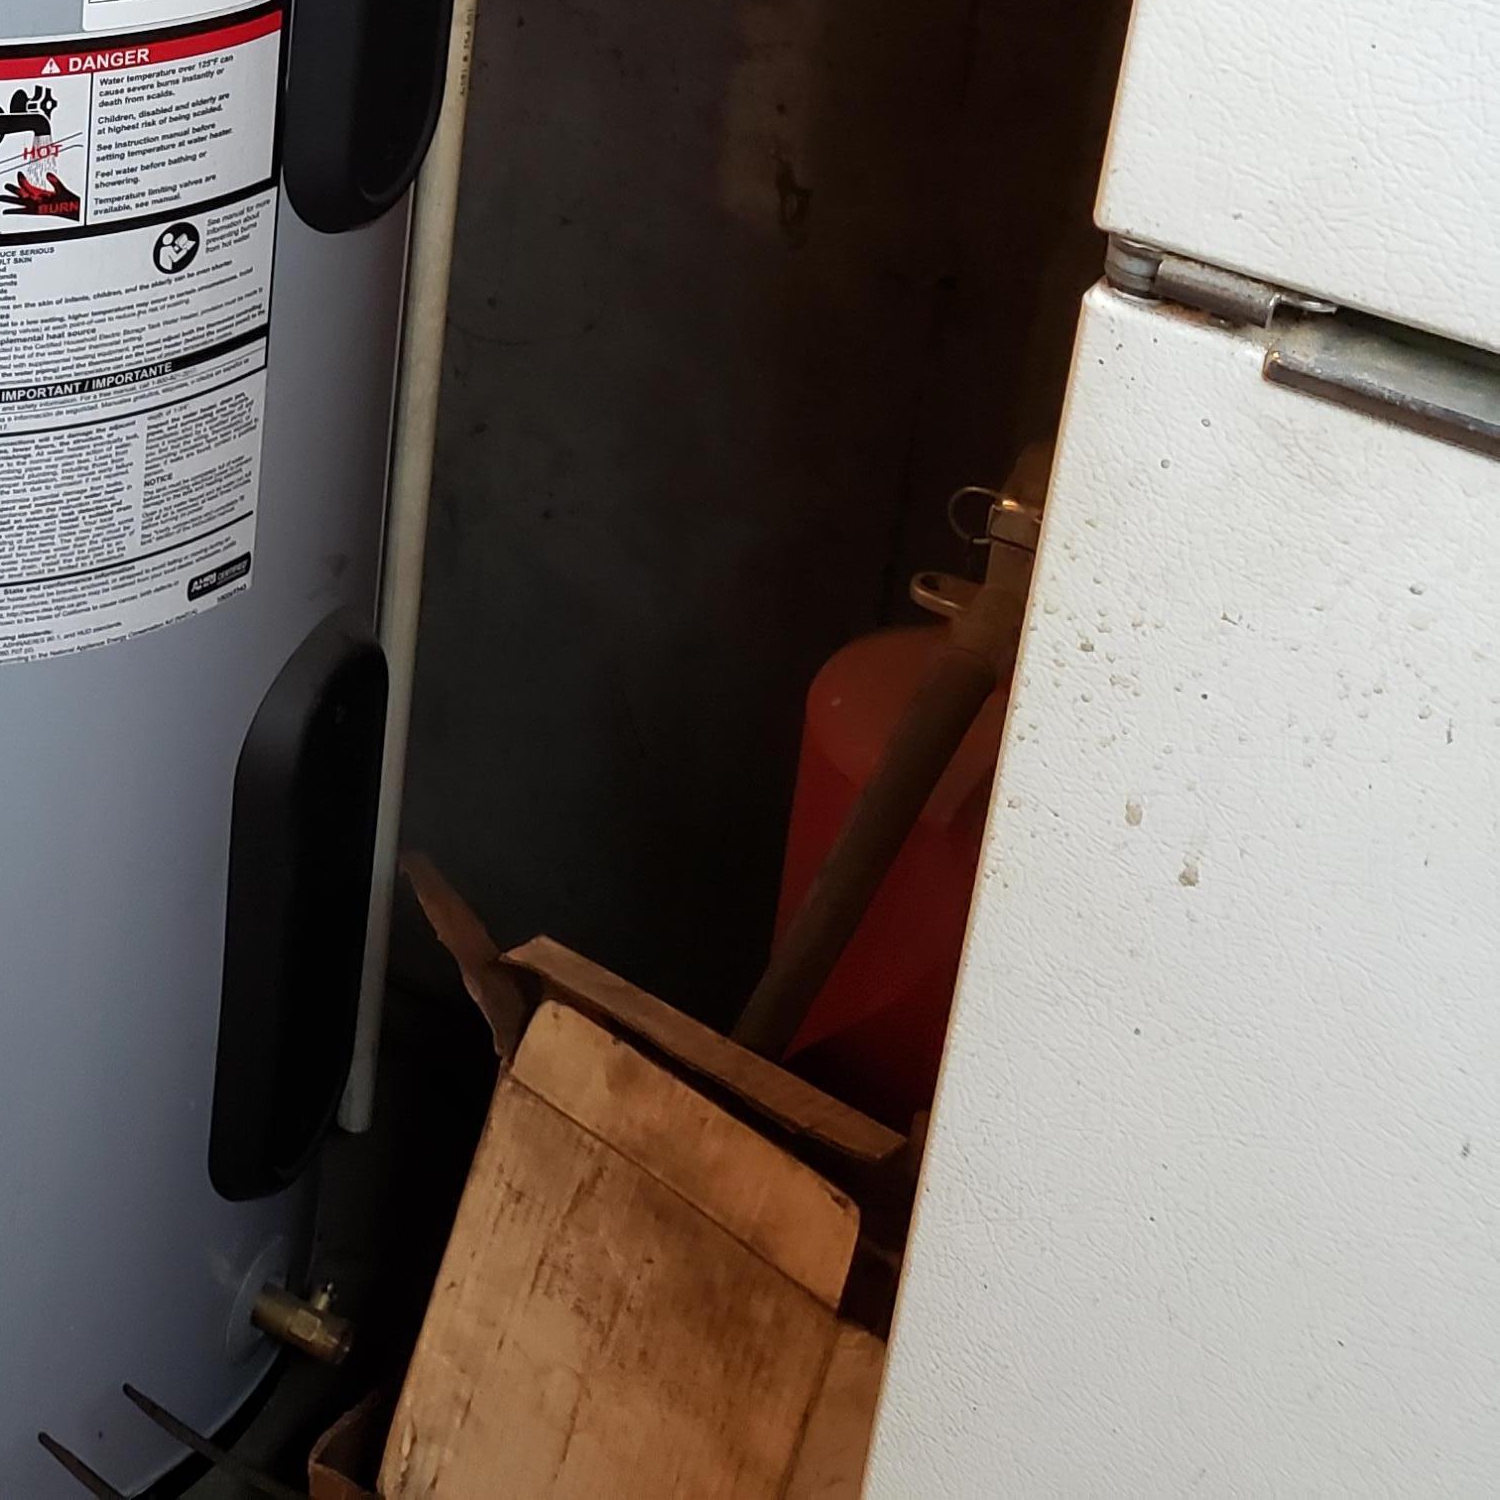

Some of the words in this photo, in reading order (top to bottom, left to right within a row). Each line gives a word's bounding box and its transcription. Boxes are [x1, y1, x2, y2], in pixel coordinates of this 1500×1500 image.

[68, 48, 150, 72] DANGER
[100, 77, 124, 87] Water
[126, 68, 176, 84] temperature
[178, 64, 196, 74] over
[220, 54, 234, 63] can
[99, 88, 124, 97] cause
[127, 84, 154, 93] severe
[156, 78, 179, 88] burns
[182, 71, 214, 83] instantly
[98, 99, 122, 107] death
[125, 95, 144, 104] from
[98, 113, 136, 124] Children,
[138, 106, 173, 118] disabled
[175, 102, 190, 111] and
[191, 95, 217, 108] elderly
[218, 92, 229, 101] are
[97, 127, 105, 135] at
[108, 123, 139, 134] highest
[141, 119, 156, 128] risk
[159, 116, 167, 124] of
[169, 111, 190, 122] being
[97, 143, 112, 151] See
[115, 135, 159, 149] instruction
[161, 128, 190, 140] manual
[192, 122, 216, 134] before
[23, 144, 63, 160] HOT
[96, 152, 125, 163] setting
[127, 142, 176, 157] temperature
[178, 140, 185, 148] at
[187, 135, 208, 144] water
[95, 169, 113, 178] Feel
[116, 165, 138, 175] water
[140, 160, 166, 171] before
[168, 153, 196, 165] bathing
[198, 150, 207, 158] or
[94, 191, 146, 205] Temperature
[148, 183, 177, 195] limiting
[179, 178, 203, 188] valves
[204, 174, 216, 182] are
[38, 201, 78, 214] BURN
[135, 200, 149, 209] see
[20, 247, 55, 256] SERIOUS
[46, 330, 65, 339] heat
[67, 328, 96, 337] source
[1, 382, 82, 402] IMPORTANT
[92, 362, 172, 390] IMPORTANTE
[144, 472, 173, 487] NOTICE
